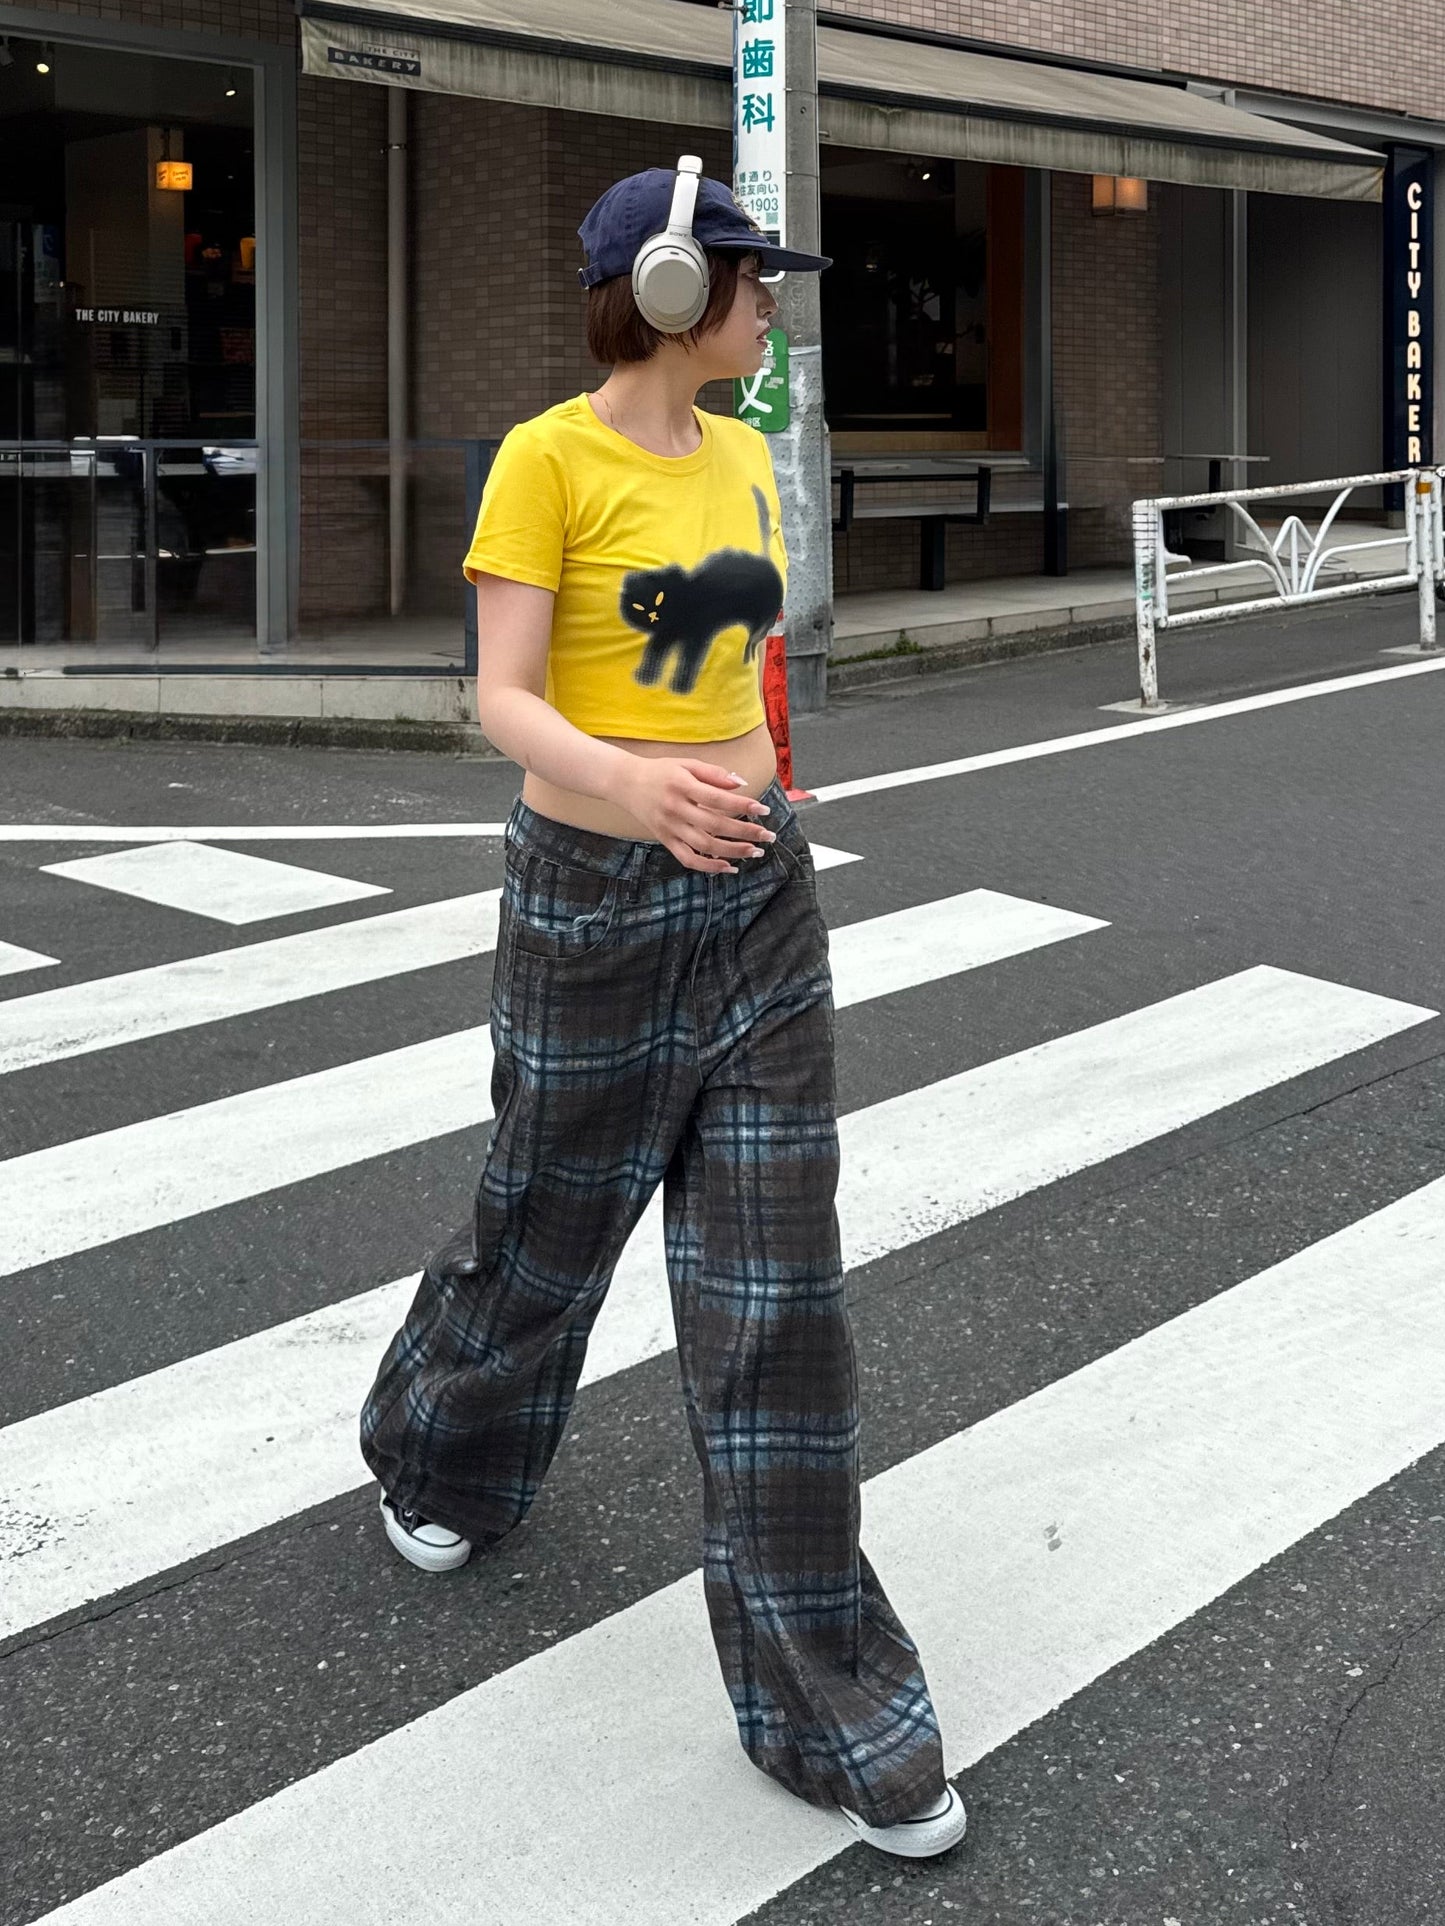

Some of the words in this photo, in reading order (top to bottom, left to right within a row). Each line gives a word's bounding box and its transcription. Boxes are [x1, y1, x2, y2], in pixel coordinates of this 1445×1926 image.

[334, 51, 416, 71] BAKERY
[1407, 181, 1422, 299] CITY
[75, 308, 94, 321] THE
[97, 309, 120, 323] CITY
[122, 310, 159, 325] BAKERY
